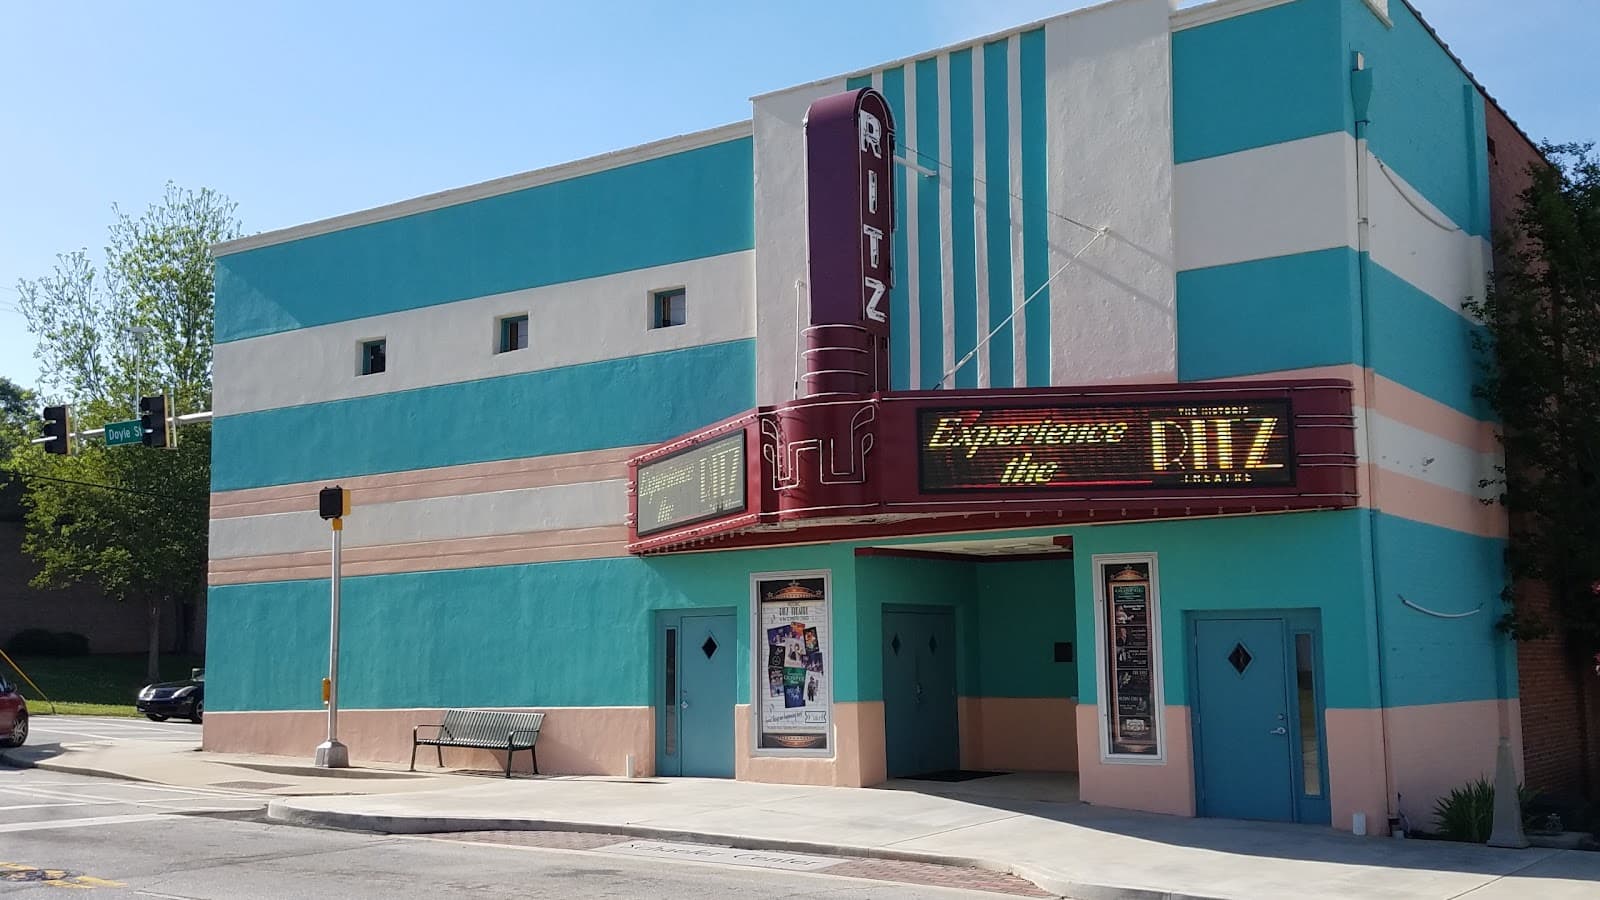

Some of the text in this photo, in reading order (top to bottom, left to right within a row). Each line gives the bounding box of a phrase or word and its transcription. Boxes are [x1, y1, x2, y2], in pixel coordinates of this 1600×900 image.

[859, 109, 888, 323] RITZ
[1178, 407, 1198, 416] THE
[108, 427, 131, 442] Doyle
[928, 418, 1129, 459] Experience
[1150, 418, 1284, 470] RITZ
[1000, 452, 1059, 484] the
